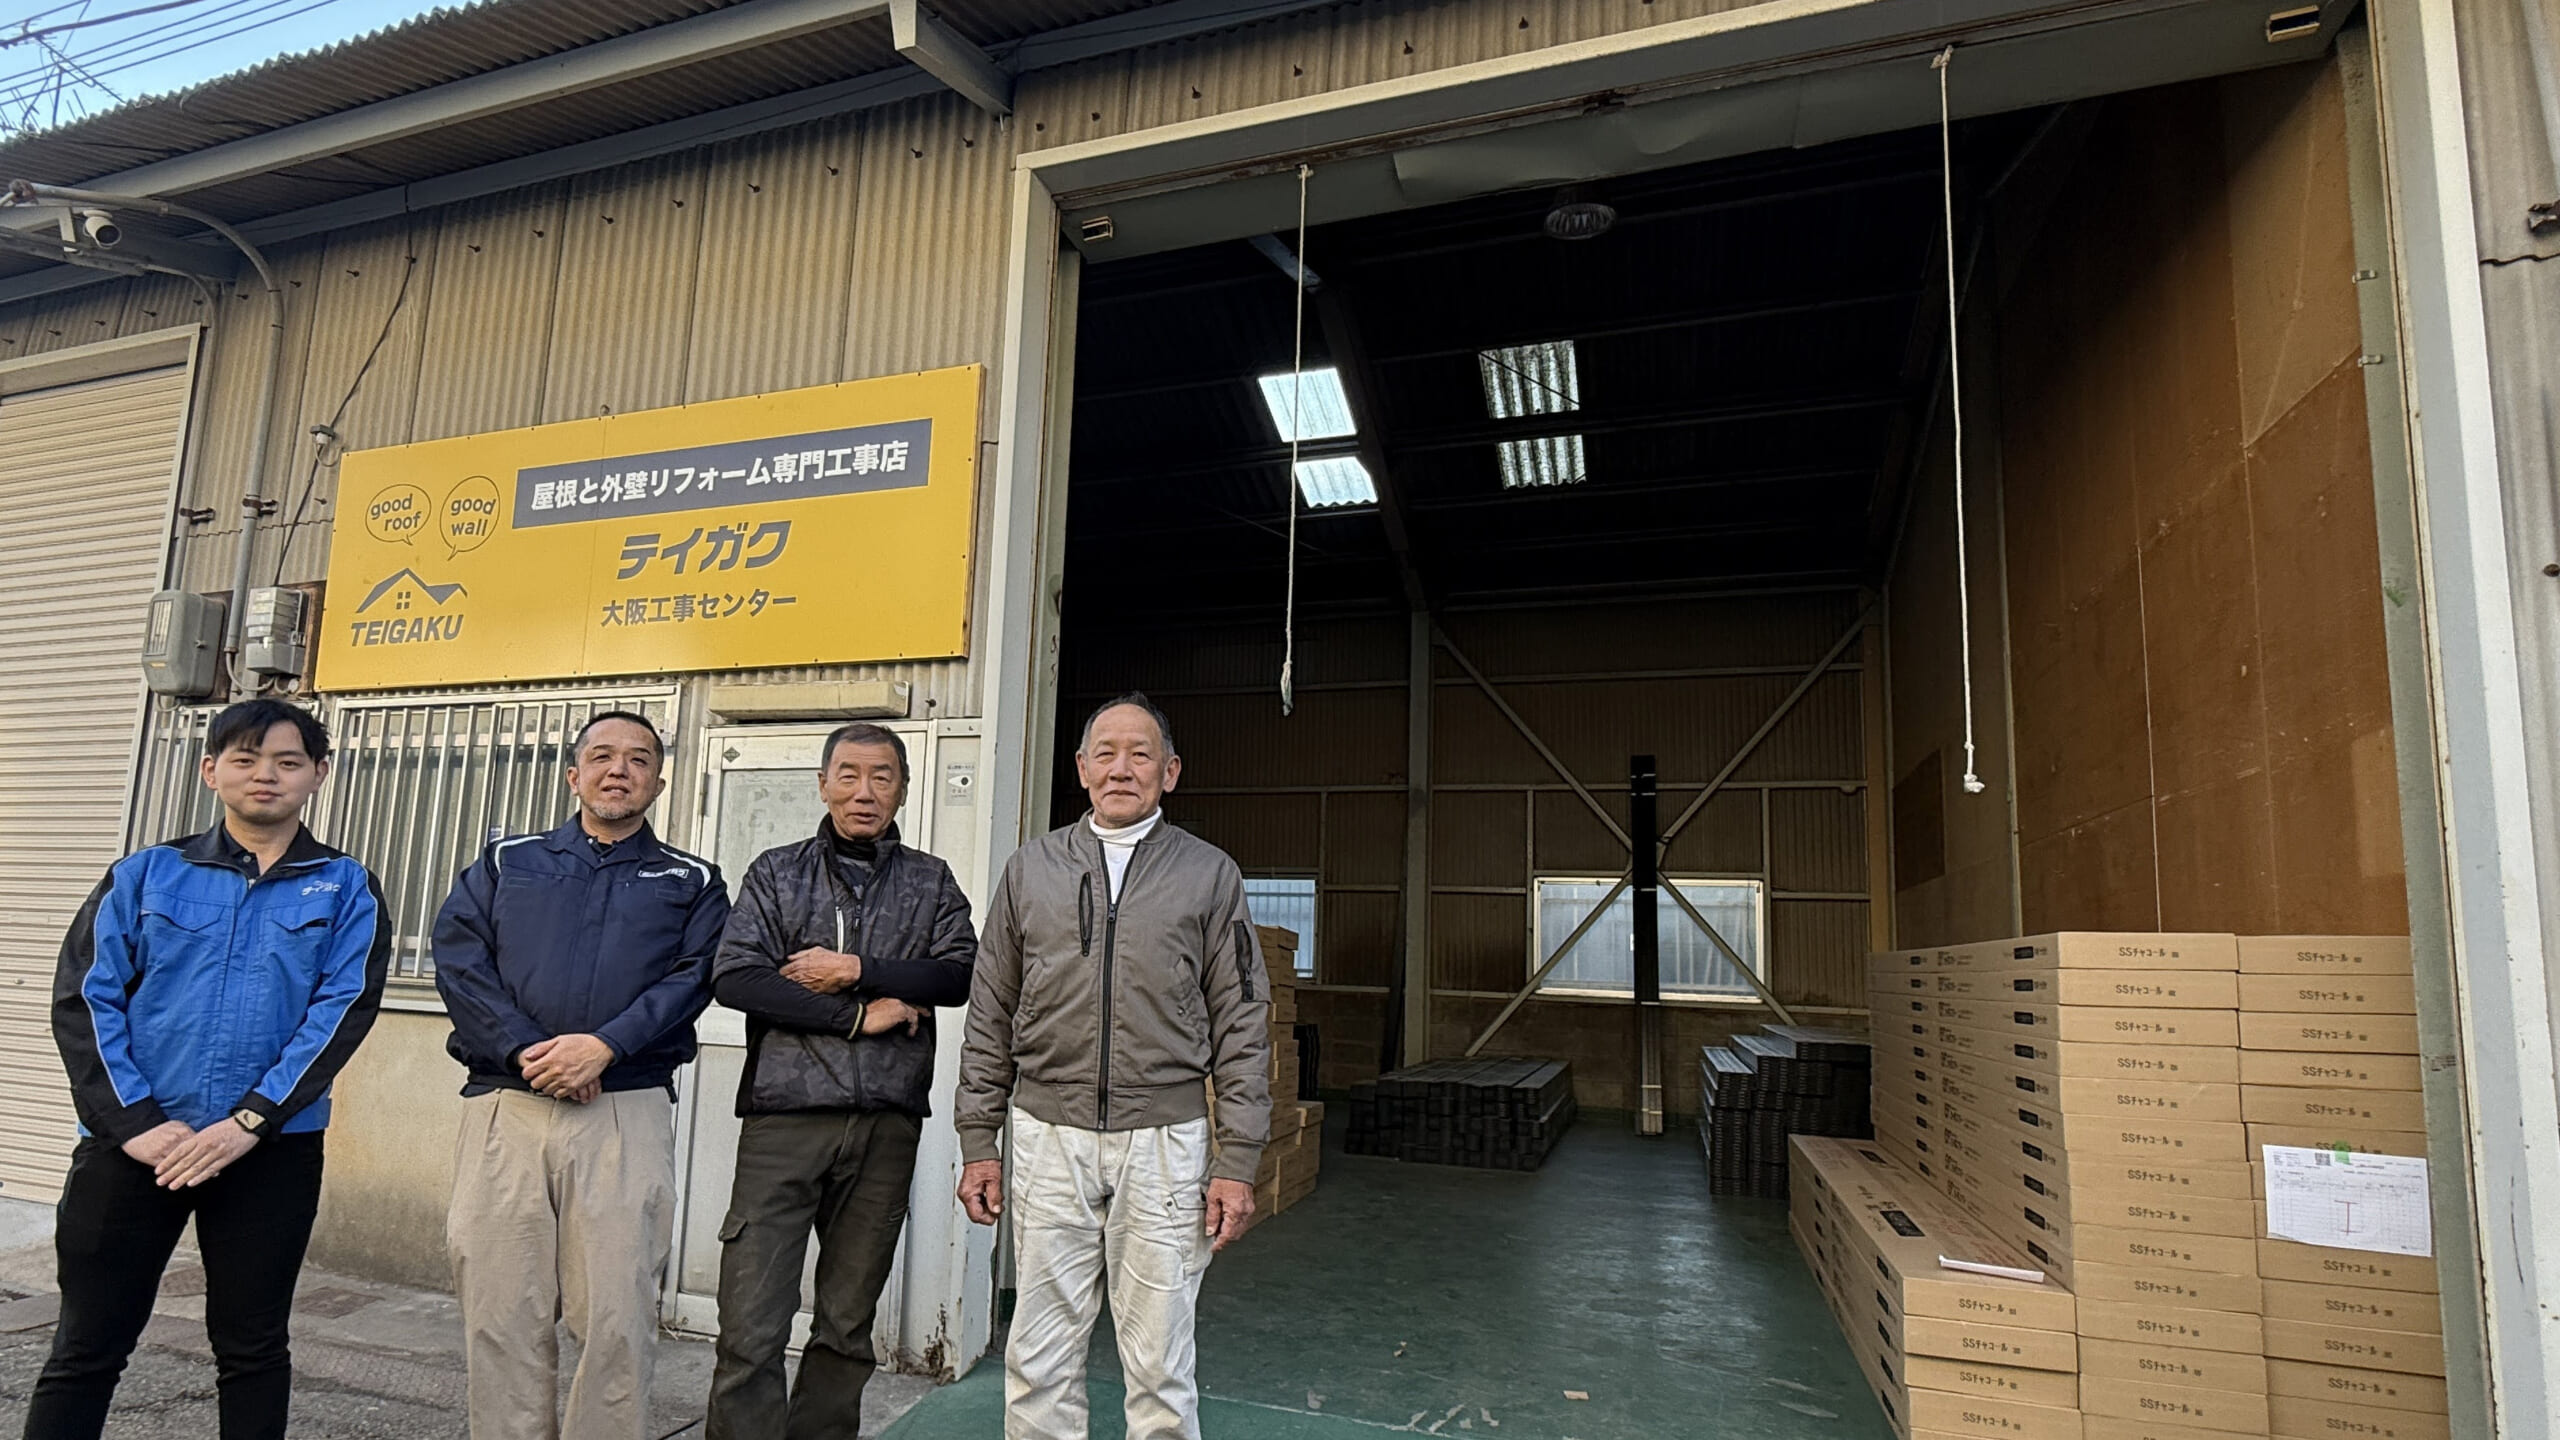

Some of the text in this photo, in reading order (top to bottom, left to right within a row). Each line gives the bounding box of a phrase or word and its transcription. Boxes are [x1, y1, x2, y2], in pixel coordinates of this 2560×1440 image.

[531, 440, 909, 511] 屋根と外壁リフォーム専門工事店
[370, 493, 413, 520] good
[384, 511, 422, 531] roof
[451, 498, 497, 516] good
[451, 519, 488, 536] wall
[616, 520, 793, 580] テイガク
[600, 588, 797, 627] 大阪工事センター
[350, 614, 465, 647] TEIGAKU
